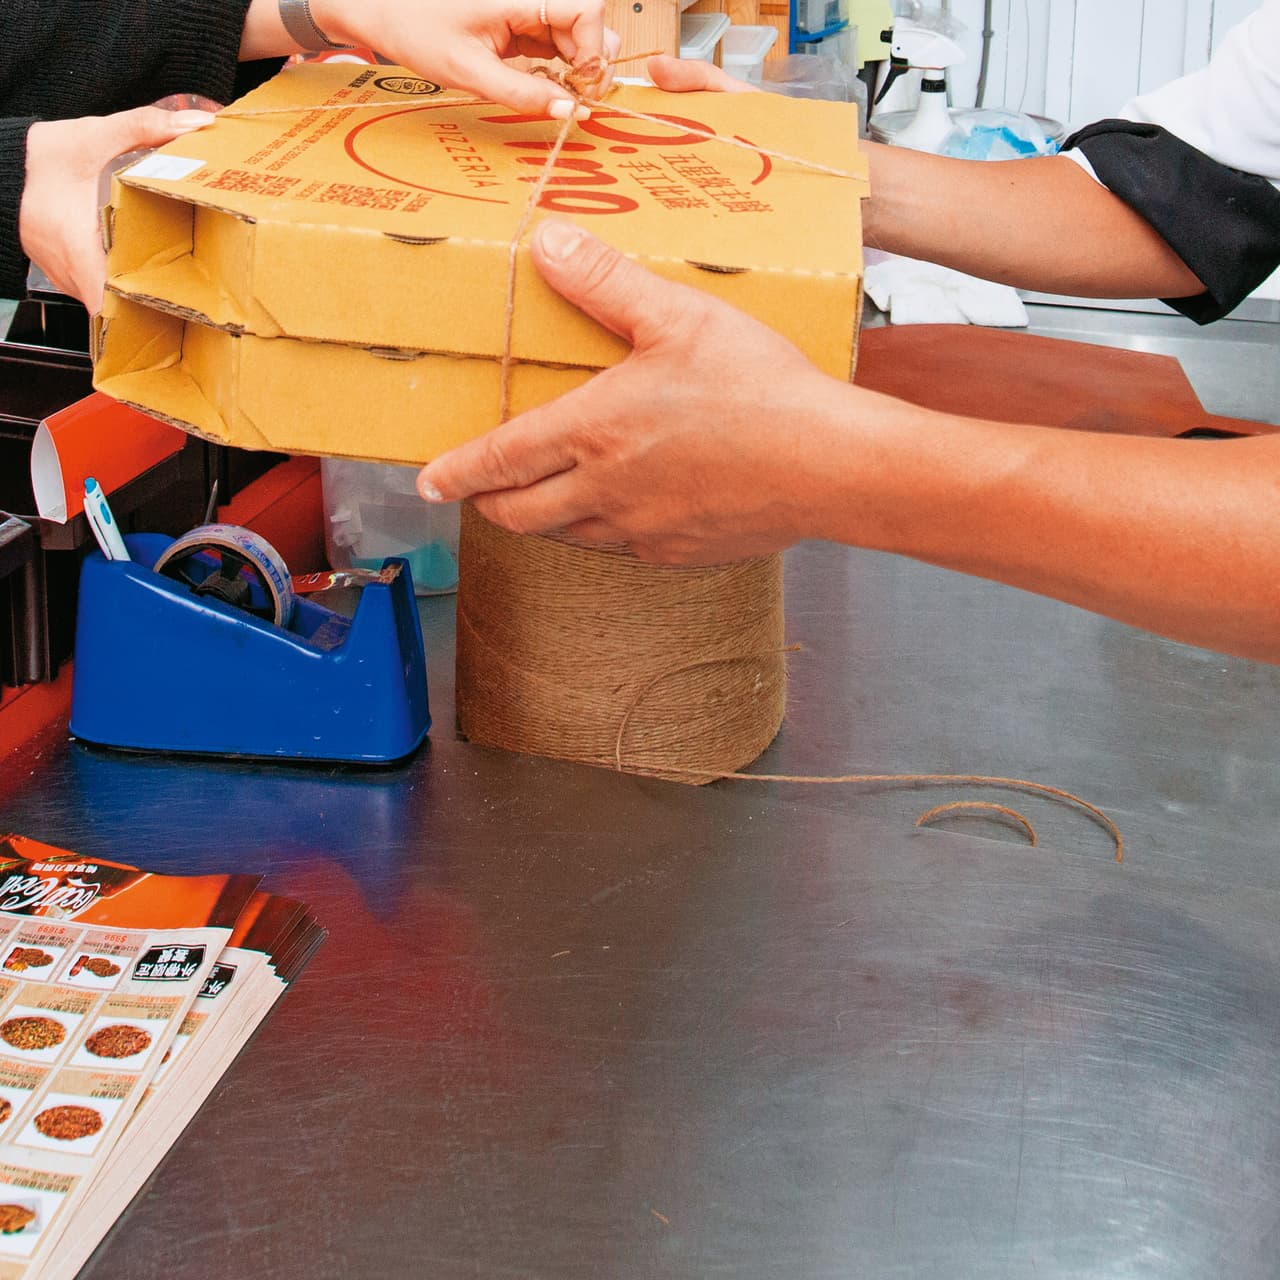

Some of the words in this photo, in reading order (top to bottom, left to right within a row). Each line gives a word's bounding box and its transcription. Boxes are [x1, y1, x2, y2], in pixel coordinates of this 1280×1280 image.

[428, 123, 504, 188] PIZZERIA
[478, 111, 717, 215] Pino
[659, 152, 774, 215] 五星級主廚
[133, 961, 197, 978] 外帶限定
[155, 947, 190, 963] 套餐
